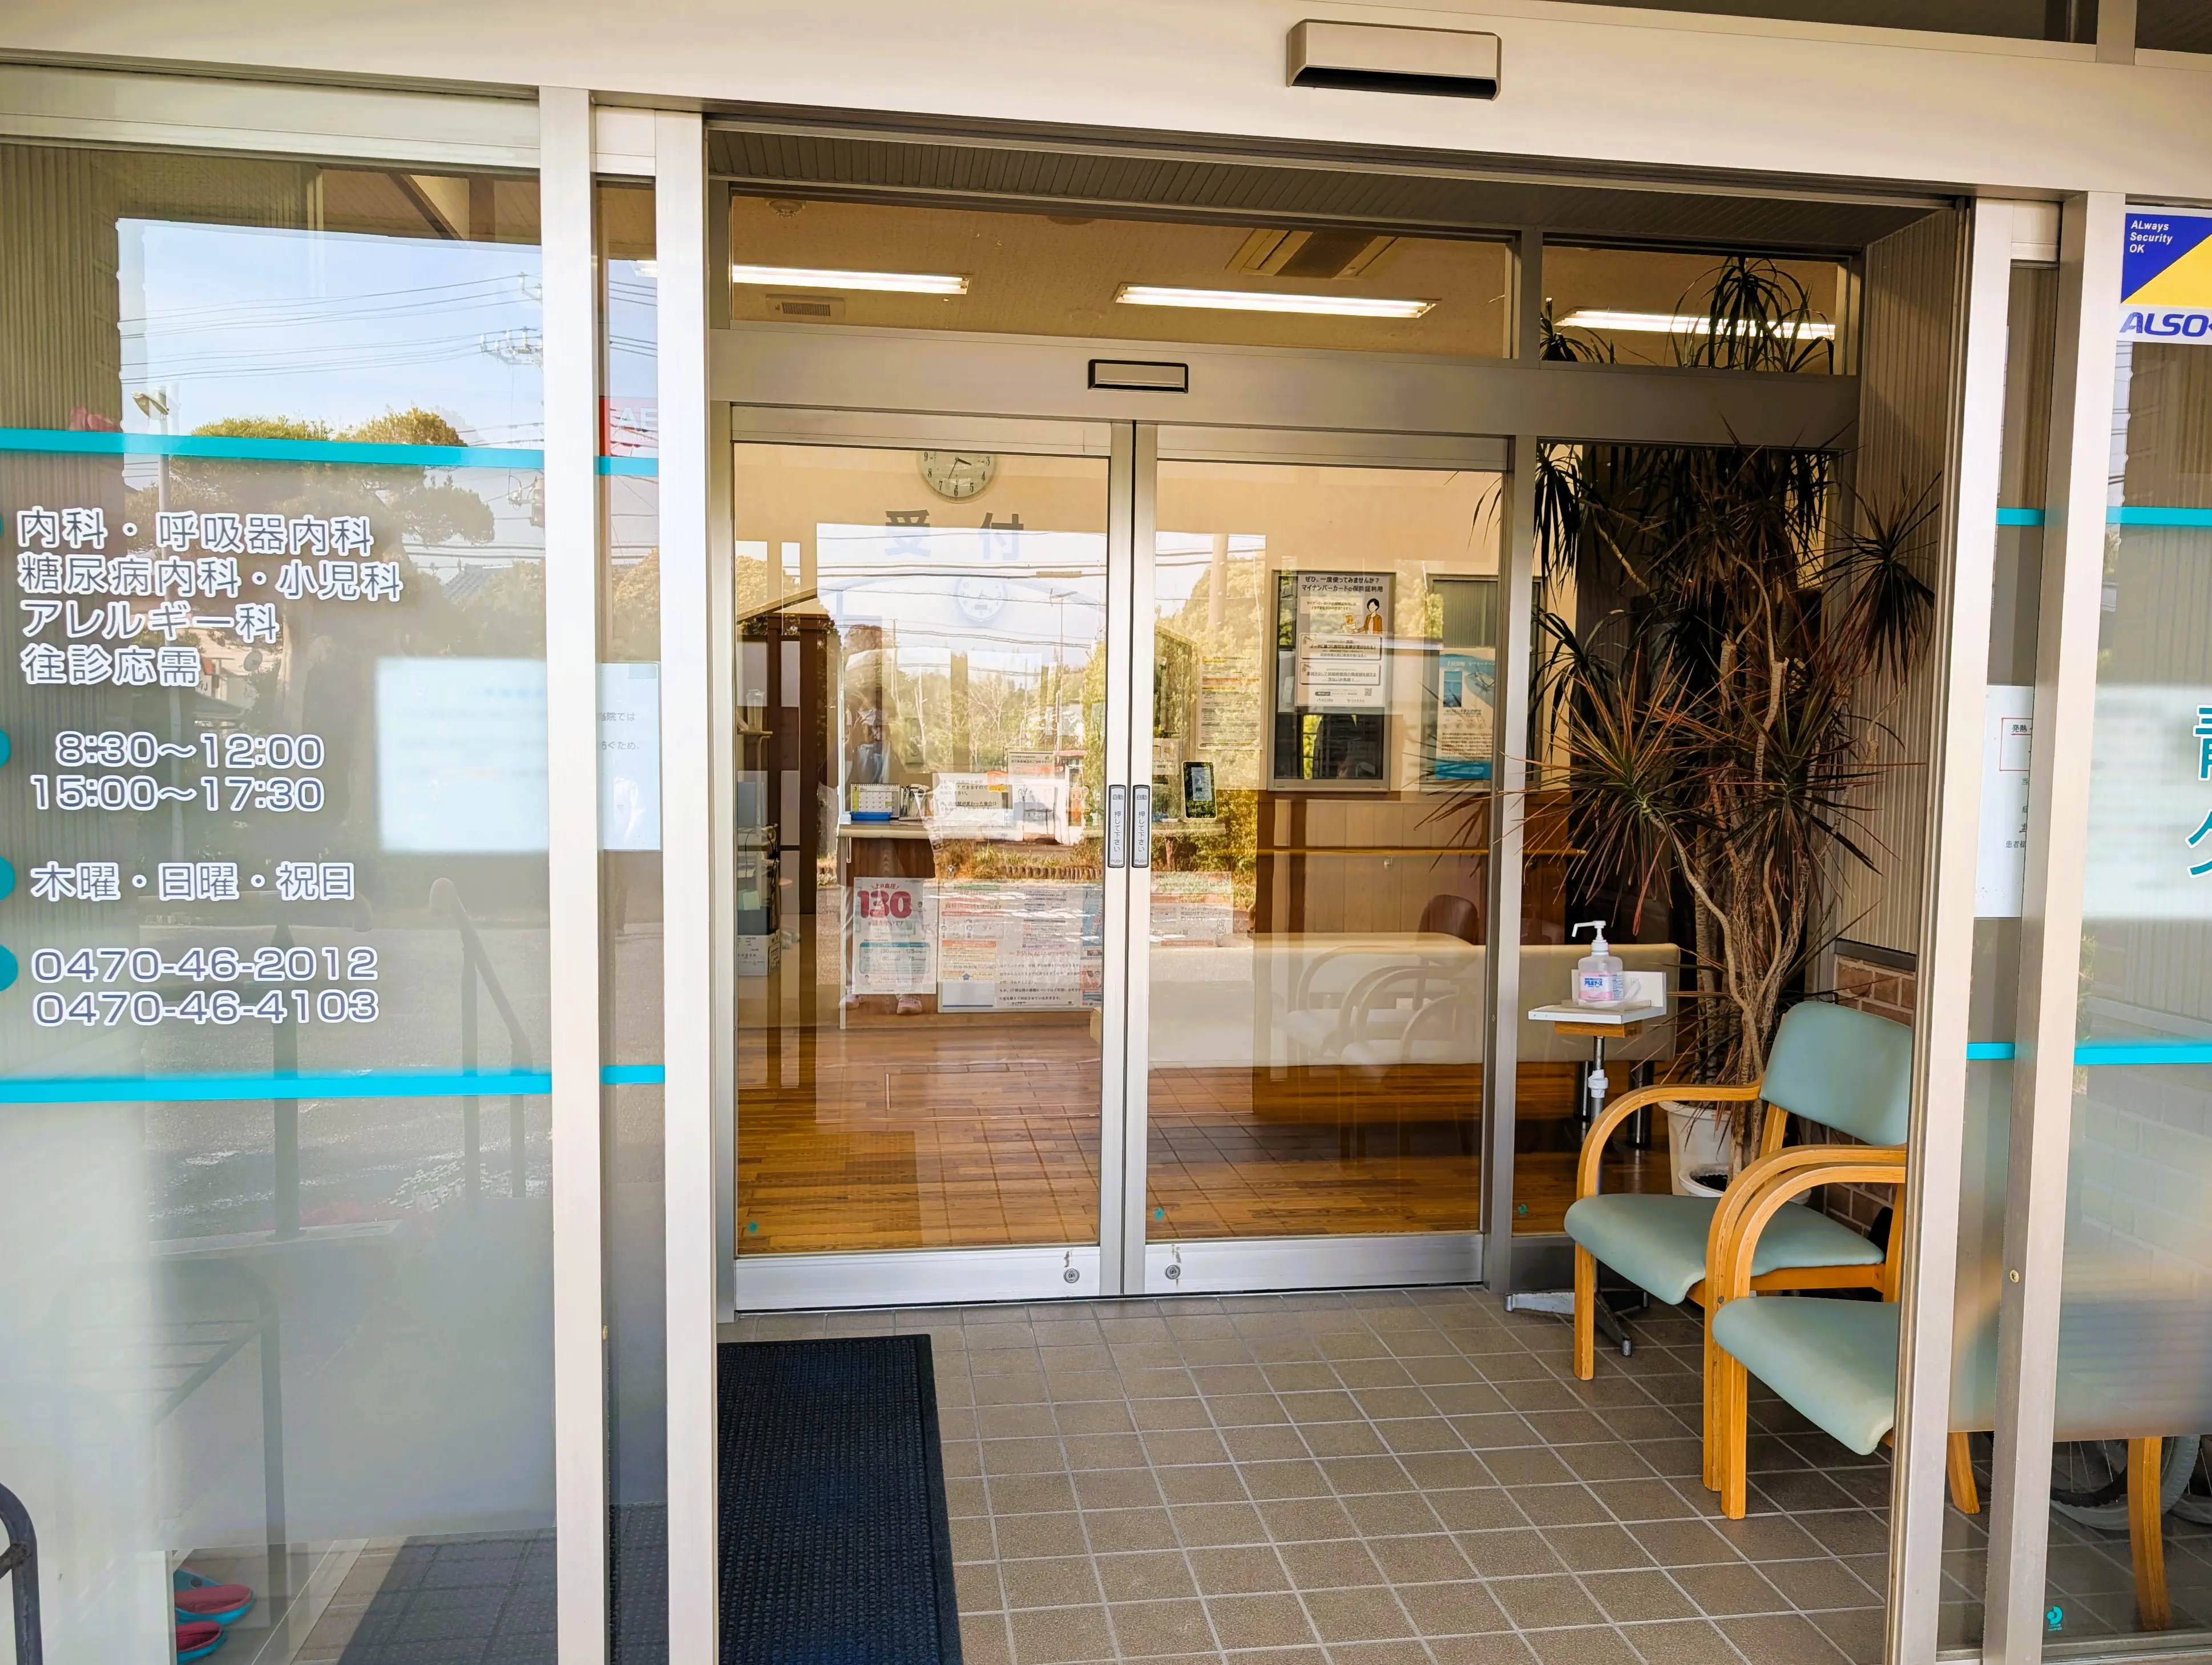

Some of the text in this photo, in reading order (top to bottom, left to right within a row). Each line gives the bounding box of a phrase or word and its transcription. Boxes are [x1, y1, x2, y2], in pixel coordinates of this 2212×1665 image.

[2130, 220, 2169, 232] ALways
[2130, 232, 2173, 245] Security
[2129, 244, 2145, 253] OK
[2120, 312, 2212, 337] ALSO
[928, 468, 932, 478] 8
[939, 479, 943, 491] 7
[981, 470, 986, 482] 4
[954, 485, 958, 496] 6
[969, 483, 974, 492] 5
[17, 506, 374, 557] 内科・呼吸器内科
[885, 510, 1024, 560] 受付
[18, 552, 403, 601] 糖尿病内科・小児科
[20, 600, 279, 644] アレルギー科
[20, 644, 201, 686] 往診応需
[31, 861, 354, 902] 木曜・日曜・祝日
[857, 890, 912, 919] 130
[31, 947, 378, 983] 0470-46-2012
[33, 989, 379, 1027] 0470-46-4103
